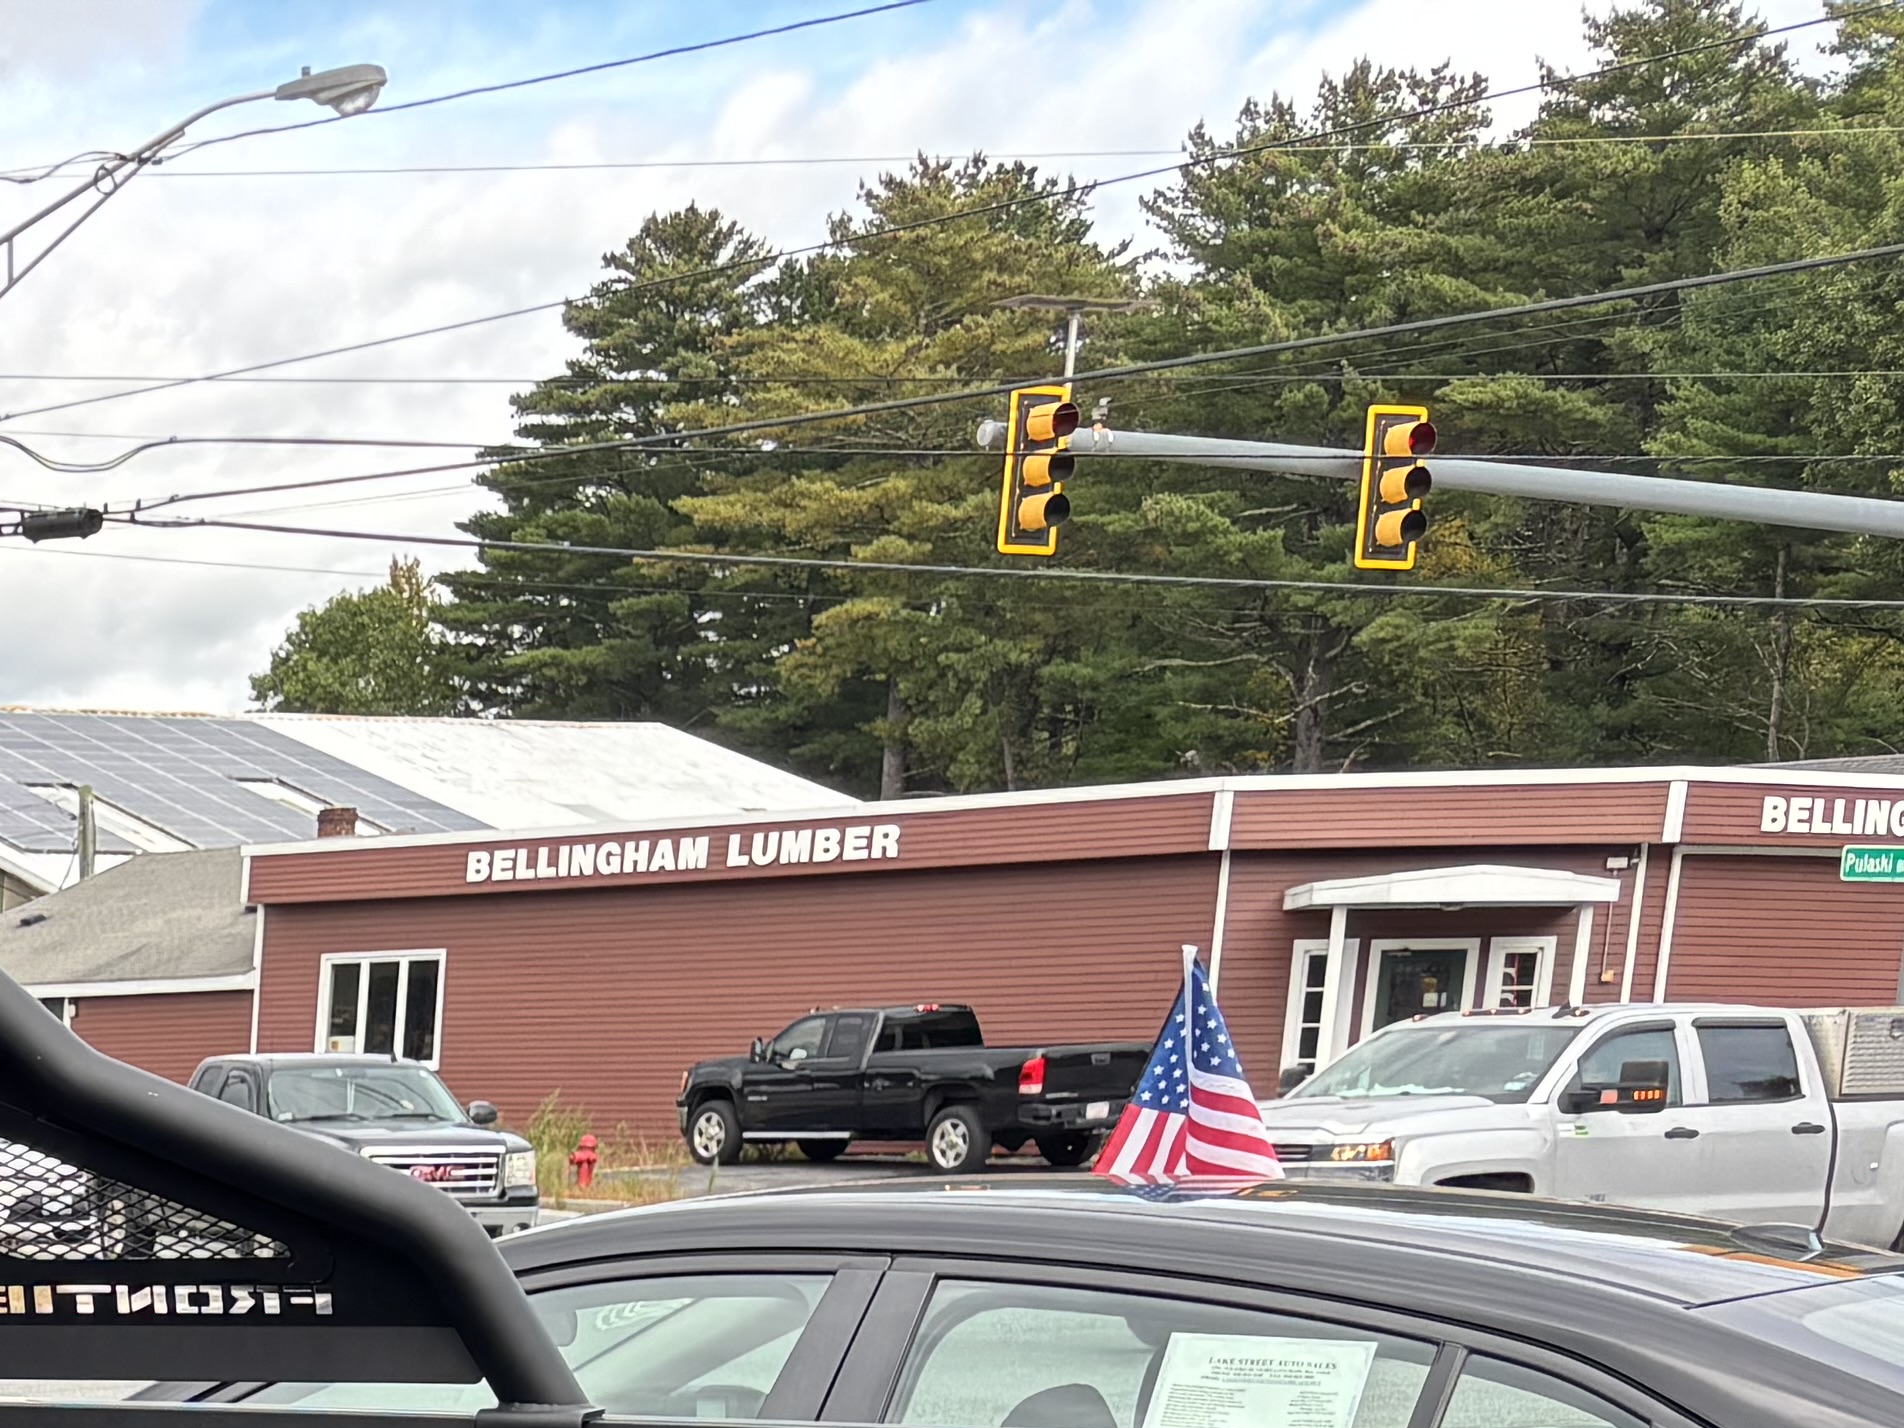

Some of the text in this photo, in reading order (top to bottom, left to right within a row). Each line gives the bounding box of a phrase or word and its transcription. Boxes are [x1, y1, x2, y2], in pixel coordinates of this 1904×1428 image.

[465, 824, 901, 882] BELLINGHAM LUMBER
[1845, 853, 1893, 874] Pulaski
[410, 1165, 465, 1183] GMC
